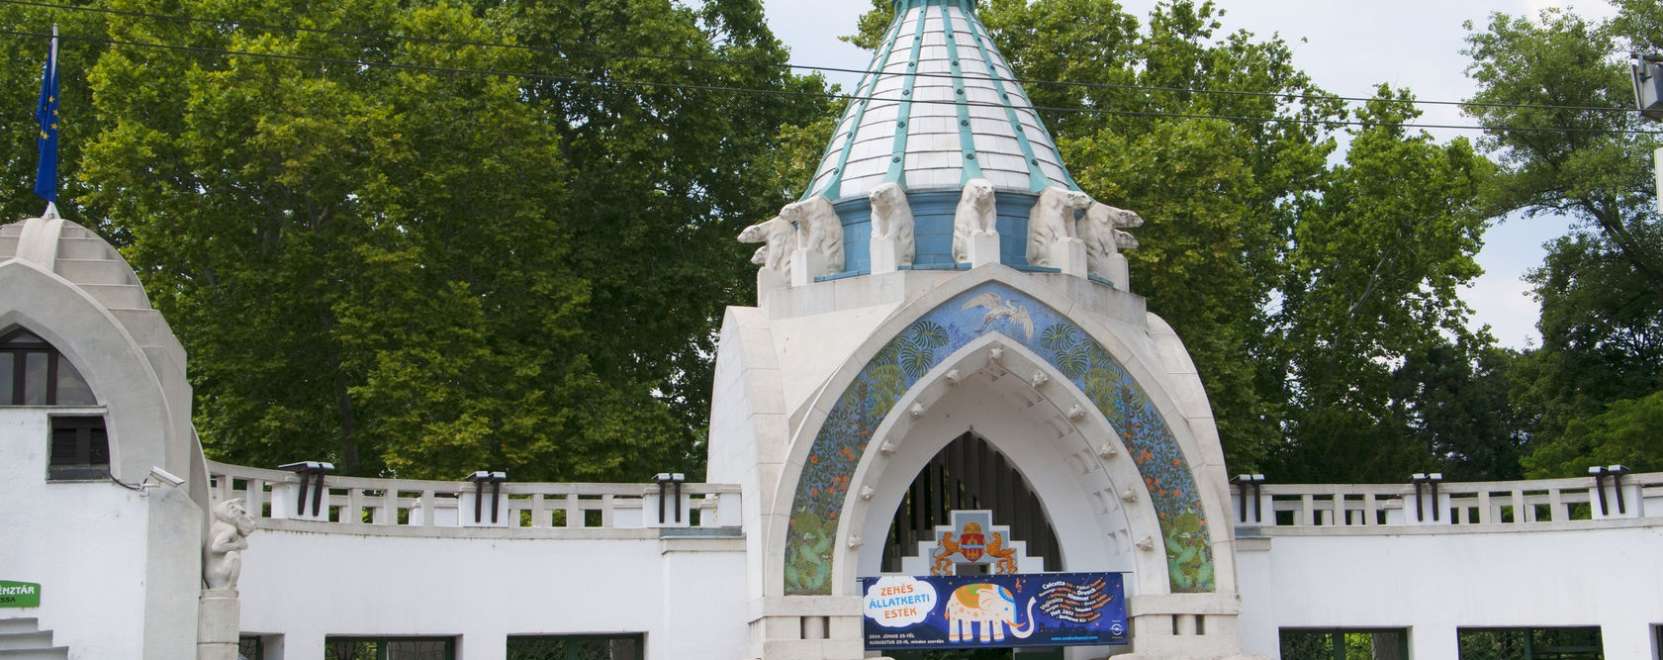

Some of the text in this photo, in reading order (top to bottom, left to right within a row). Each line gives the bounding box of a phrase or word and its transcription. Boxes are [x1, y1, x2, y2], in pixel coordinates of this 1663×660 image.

[880, 584, 914, 597] ZENÉS
[869, 594, 930, 609] ÁLLATKERTI
[884, 607, 917, 619] ESTÉK
